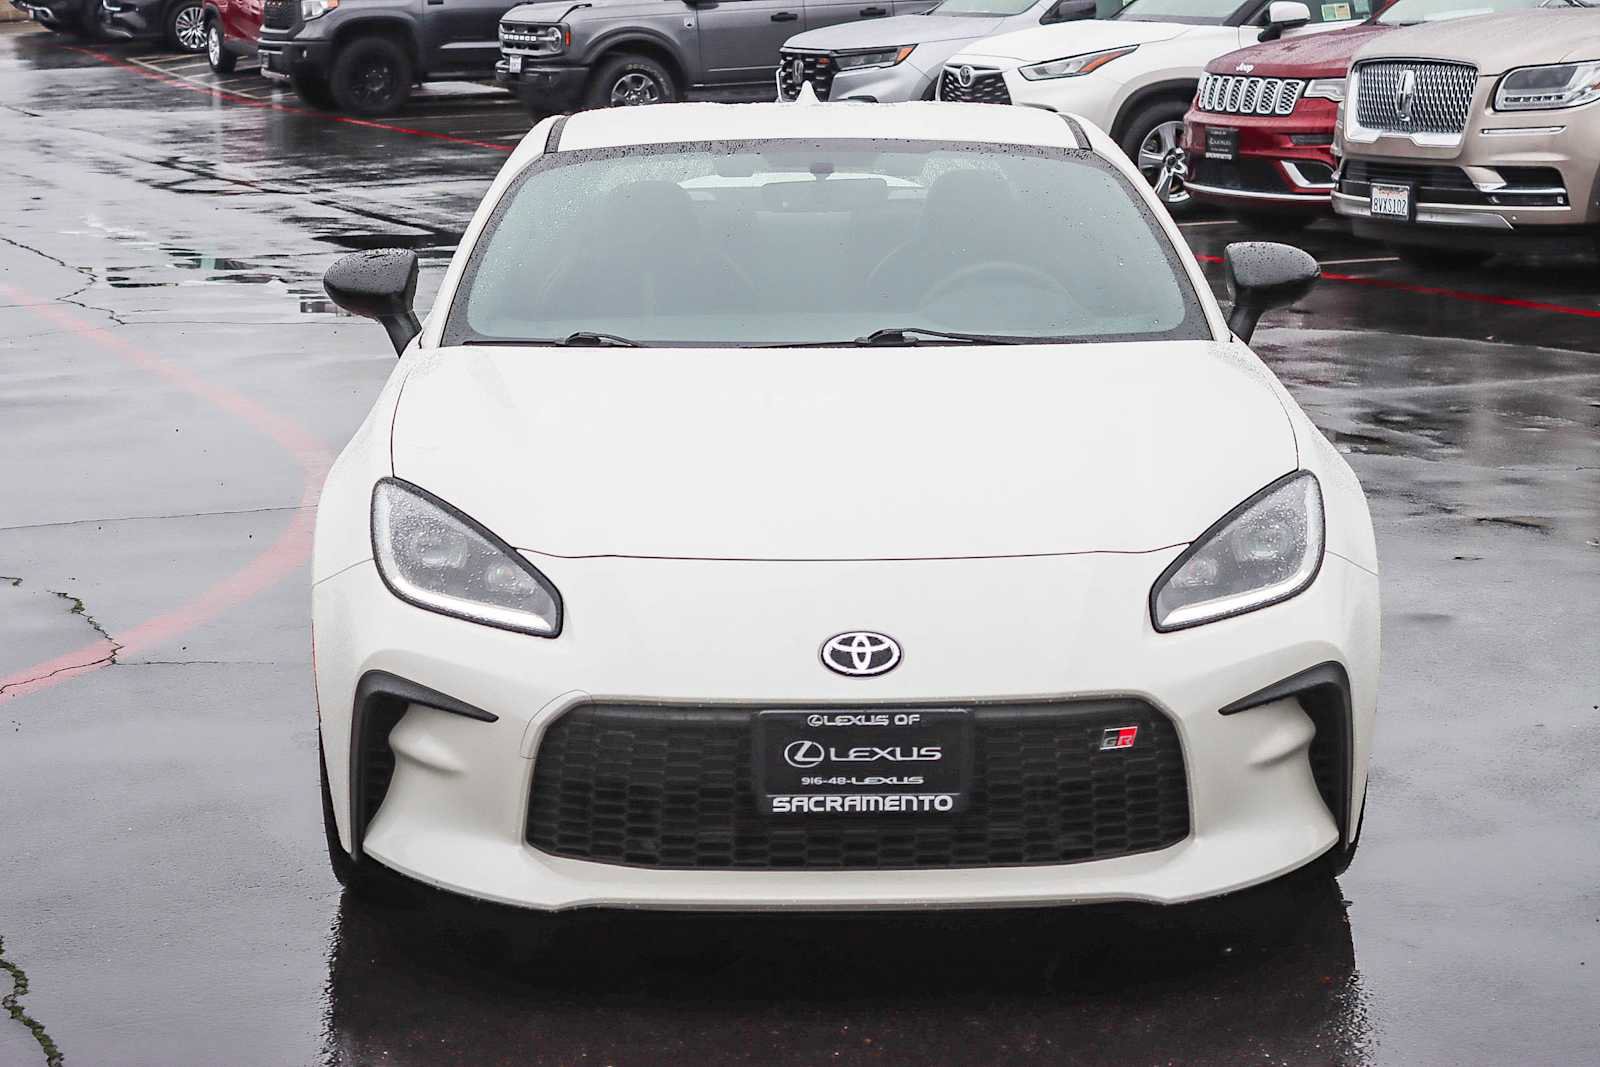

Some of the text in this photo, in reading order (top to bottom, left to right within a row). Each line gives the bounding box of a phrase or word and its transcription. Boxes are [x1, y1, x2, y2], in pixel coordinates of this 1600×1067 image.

[1373, 197, 1407, 214] 8VXS102
[824, 714, 921, 726] LEXUS OF
[830, 747, 942, 761] LEXUS
[801, 776, 925, 785] 916-48-LEXUS
[772, 795, 953, 813] SACRAMENTO
